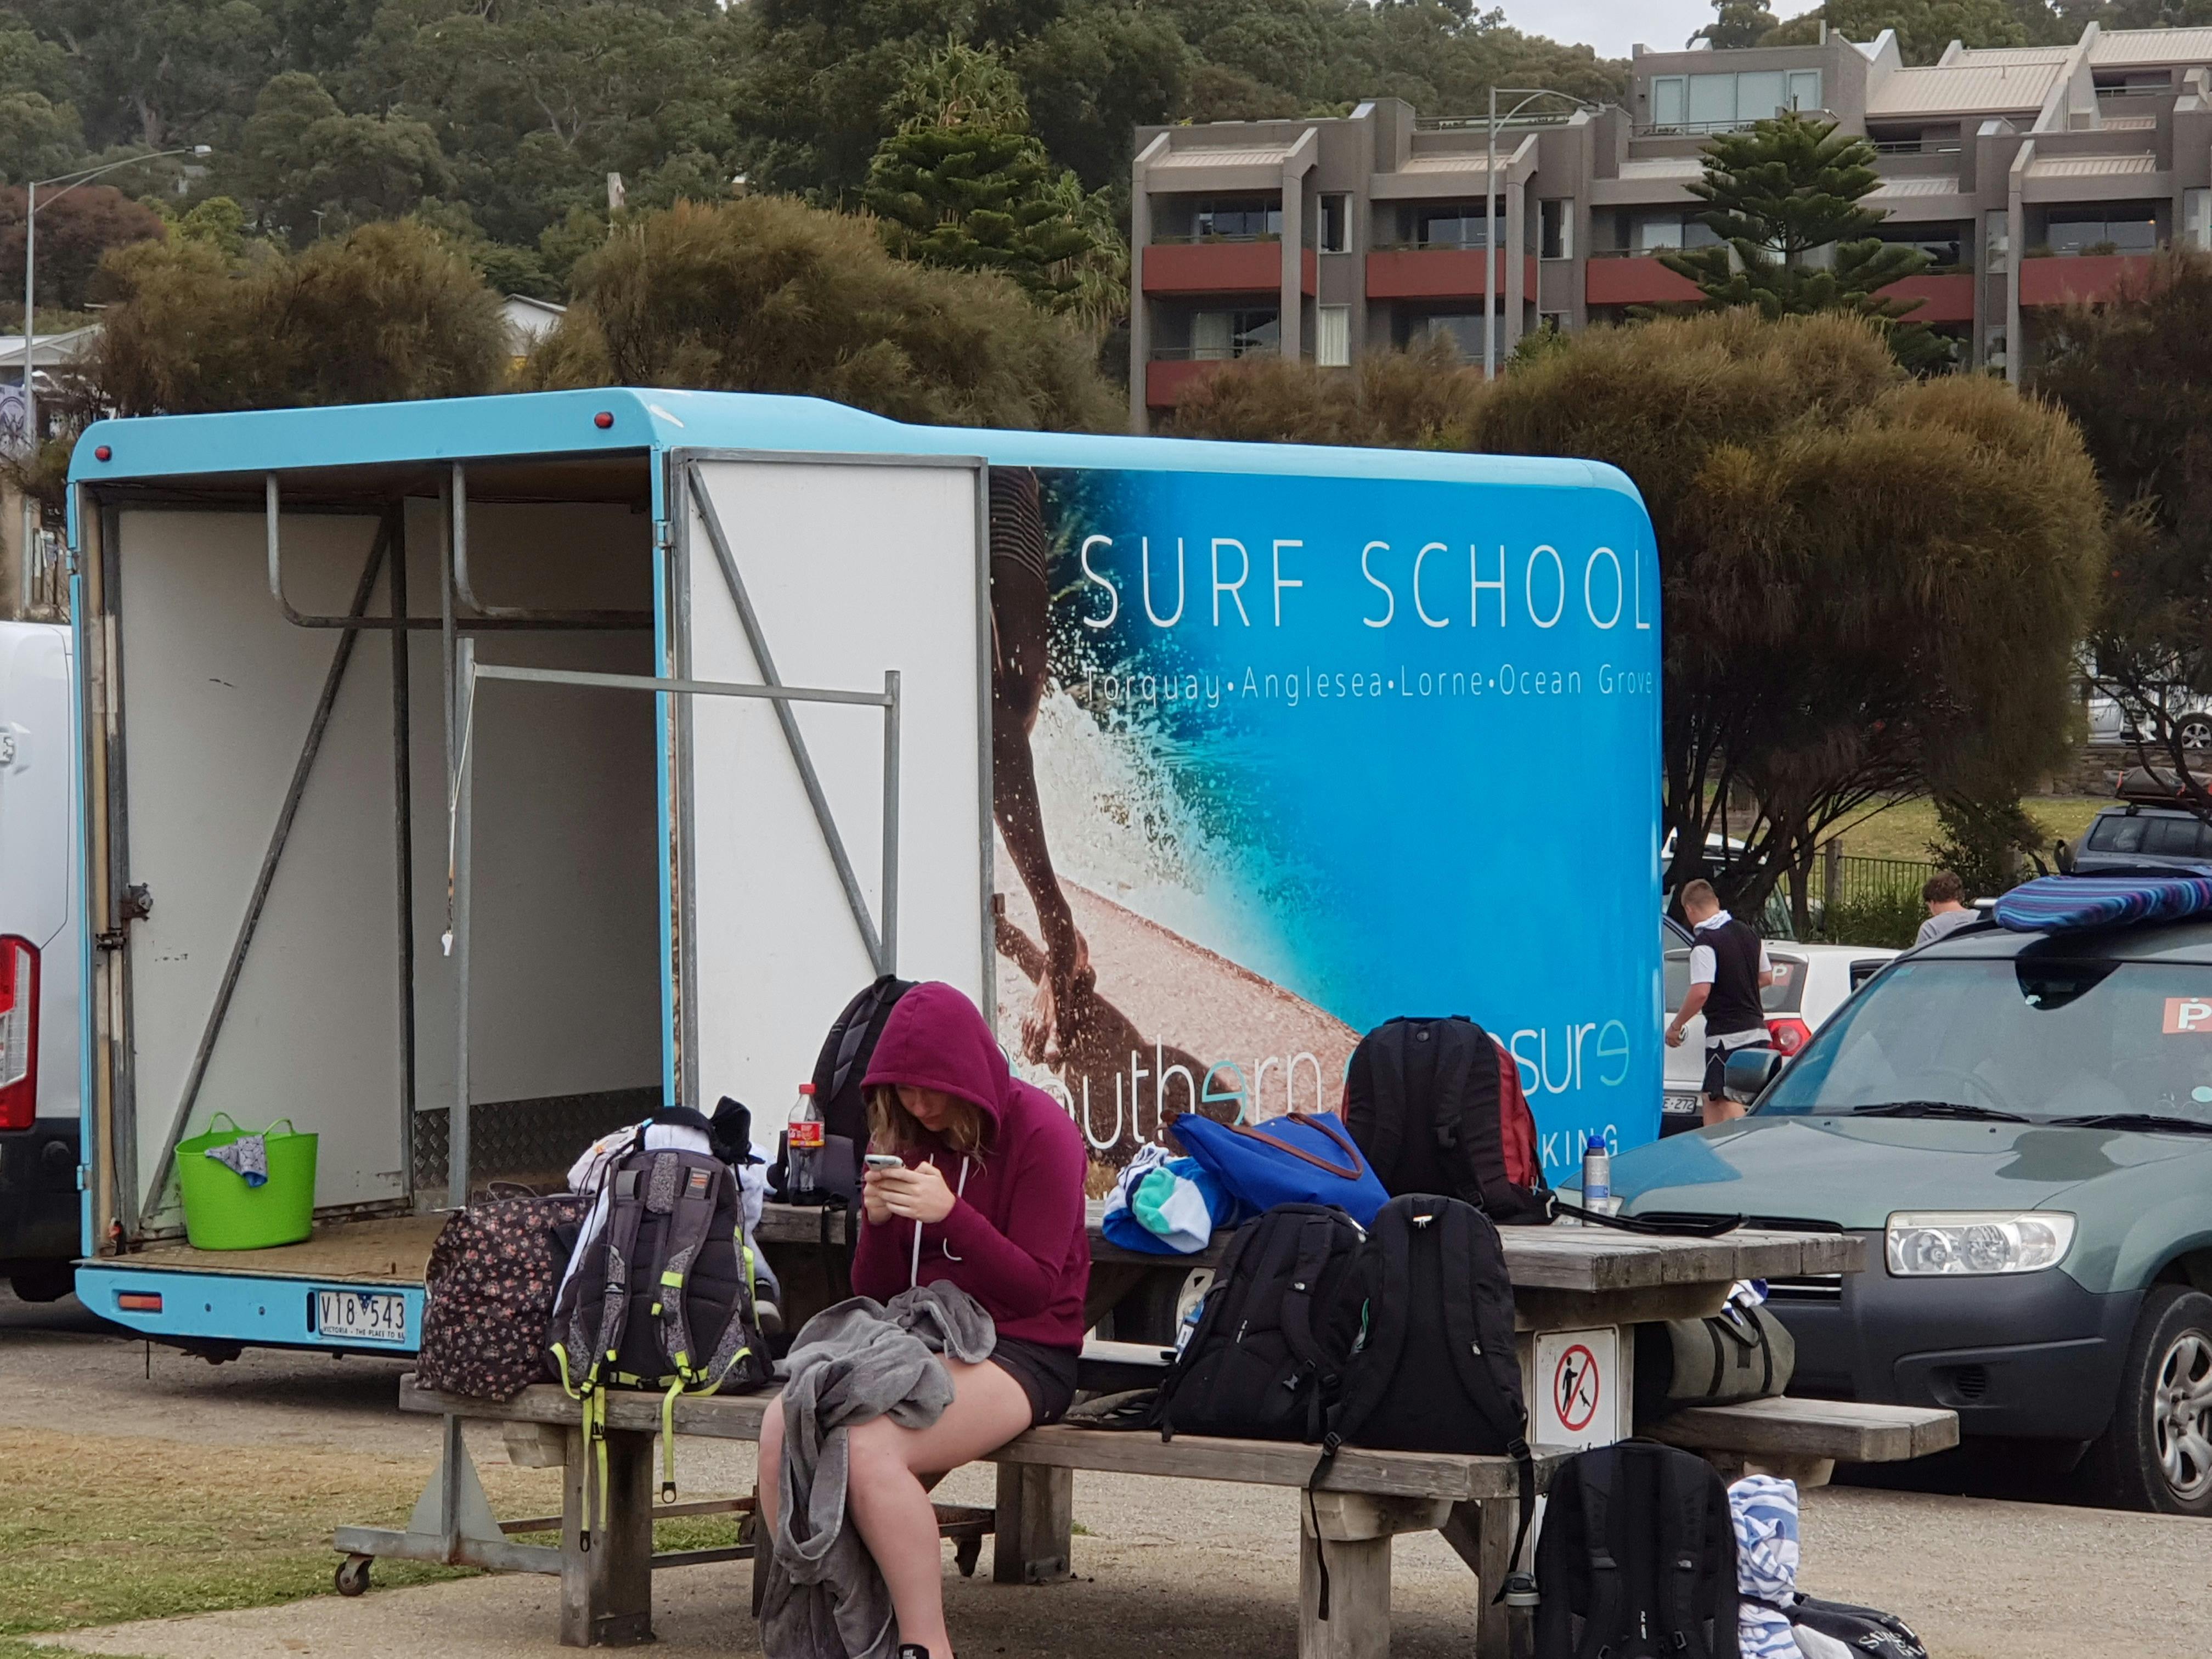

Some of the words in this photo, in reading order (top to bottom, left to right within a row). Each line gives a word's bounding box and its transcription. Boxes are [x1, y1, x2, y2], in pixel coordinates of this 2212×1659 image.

[1081, 534, 1304, 628] SURF
[1361, 540, 1650, 629] SCHOOL
[1599, 663, 1652, 694] Grove
